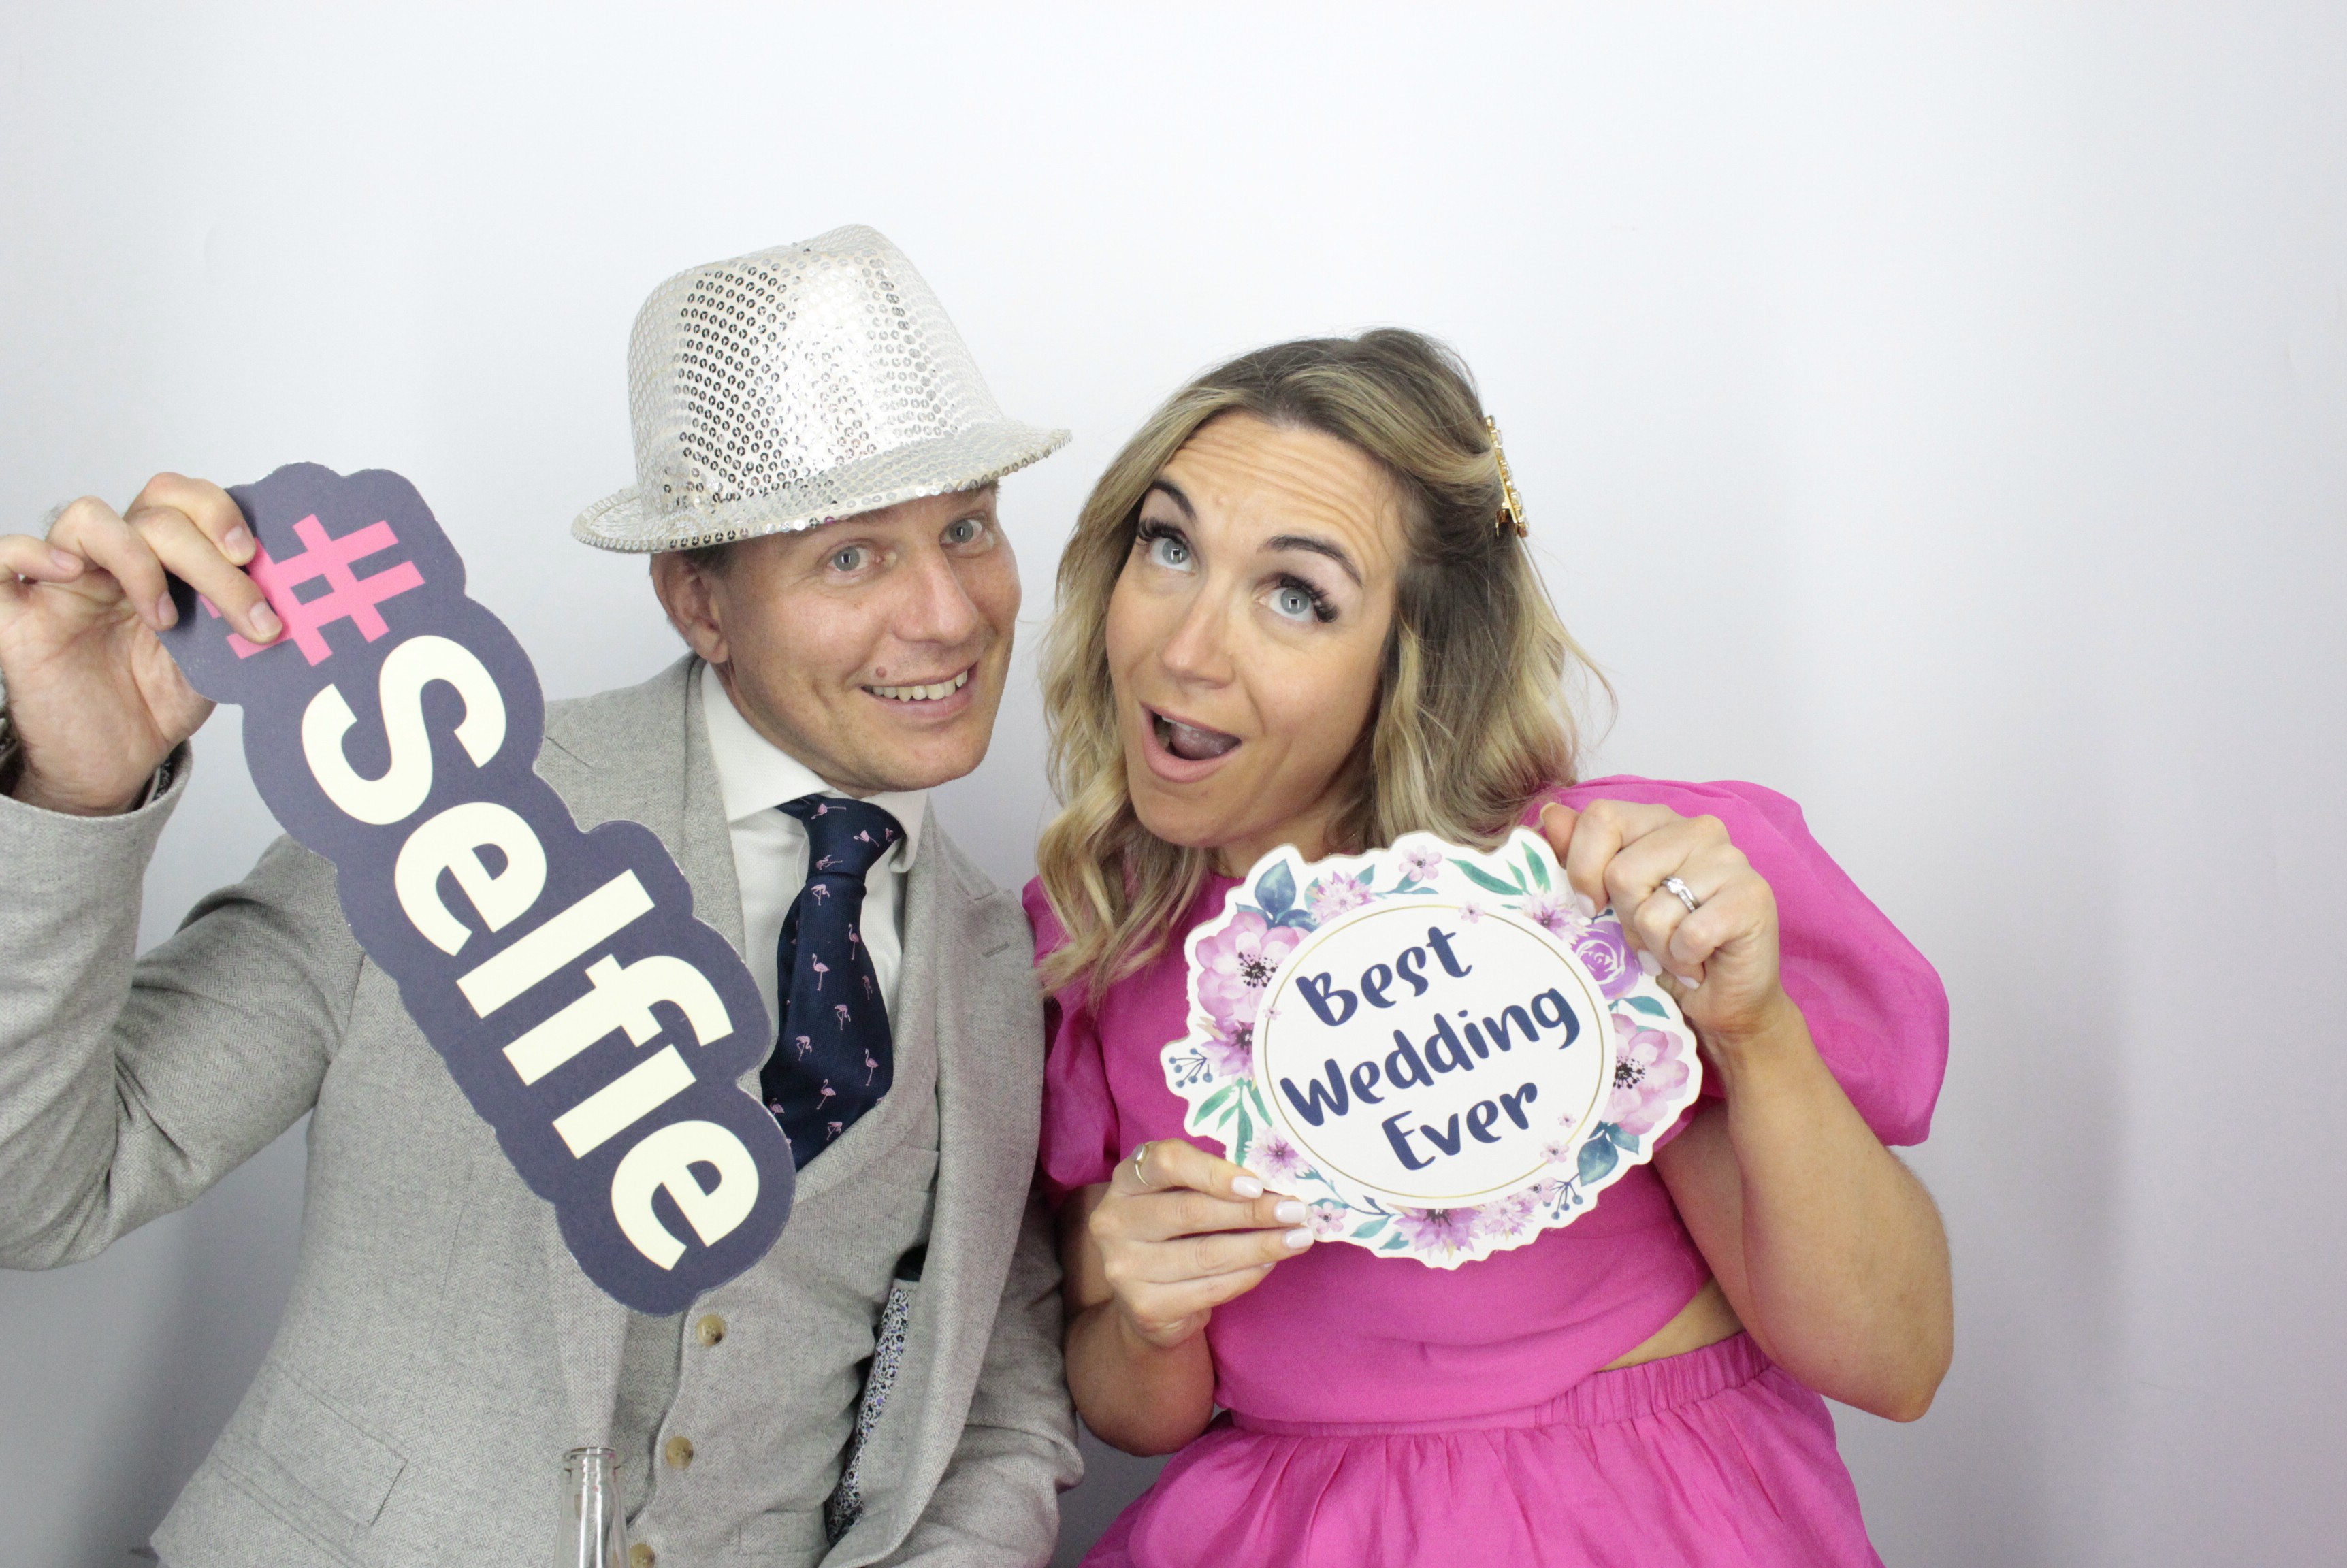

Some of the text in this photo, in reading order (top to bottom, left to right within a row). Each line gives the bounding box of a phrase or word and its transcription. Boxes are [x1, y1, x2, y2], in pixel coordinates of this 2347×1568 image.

[199, 513, 760, 1271] #Selfie
[1295, 926, 1473, 1027] Best
[1279, 987, 1581, 1127] Wedding
[1381, 1082, 1538, 1171] Ever
